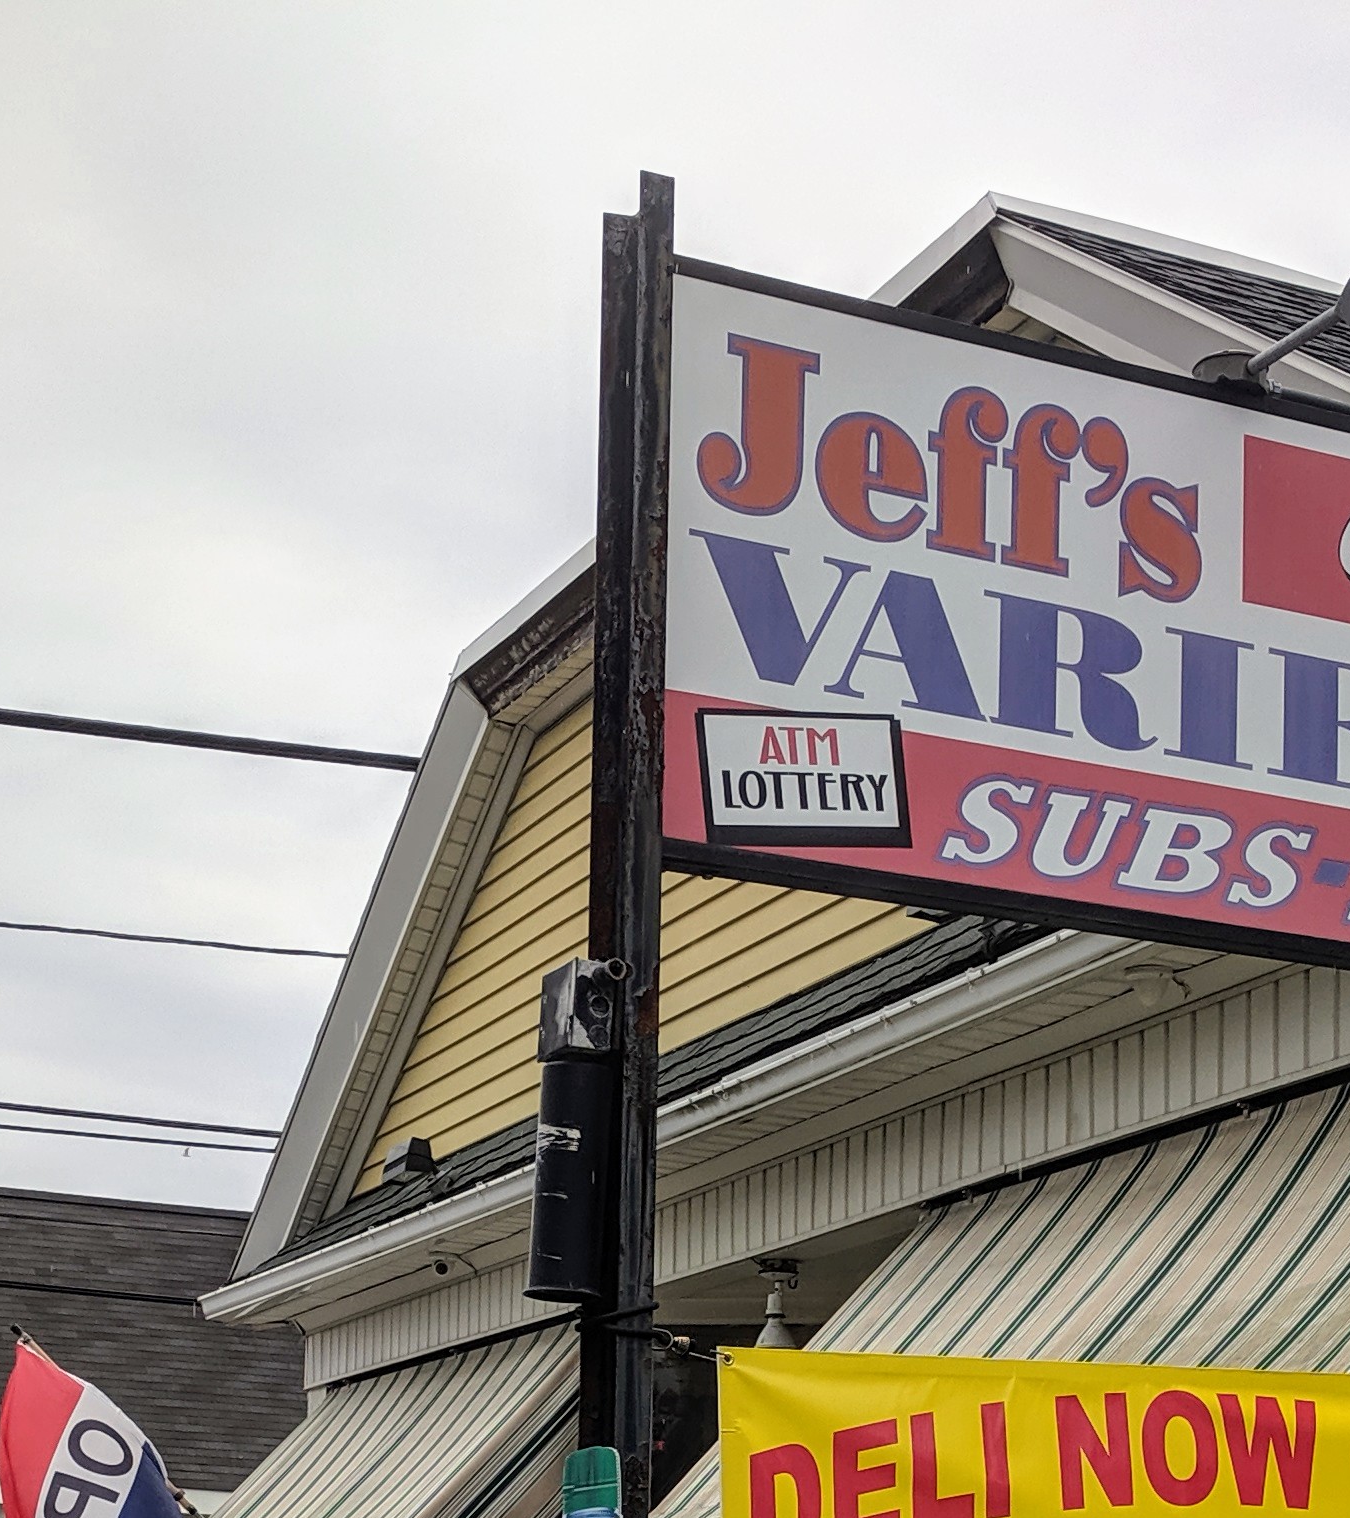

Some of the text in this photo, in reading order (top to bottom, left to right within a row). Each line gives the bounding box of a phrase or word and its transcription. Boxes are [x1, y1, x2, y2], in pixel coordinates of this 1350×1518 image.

[695, 332, 1202, 603] Jeff's
[721, 769, 889, 812] LOTTERY
[759, 726, 841, 766] ATM
[938, 773, 1314, 912] SUBS
[1056, 1389, 1317, 1511] NOW
